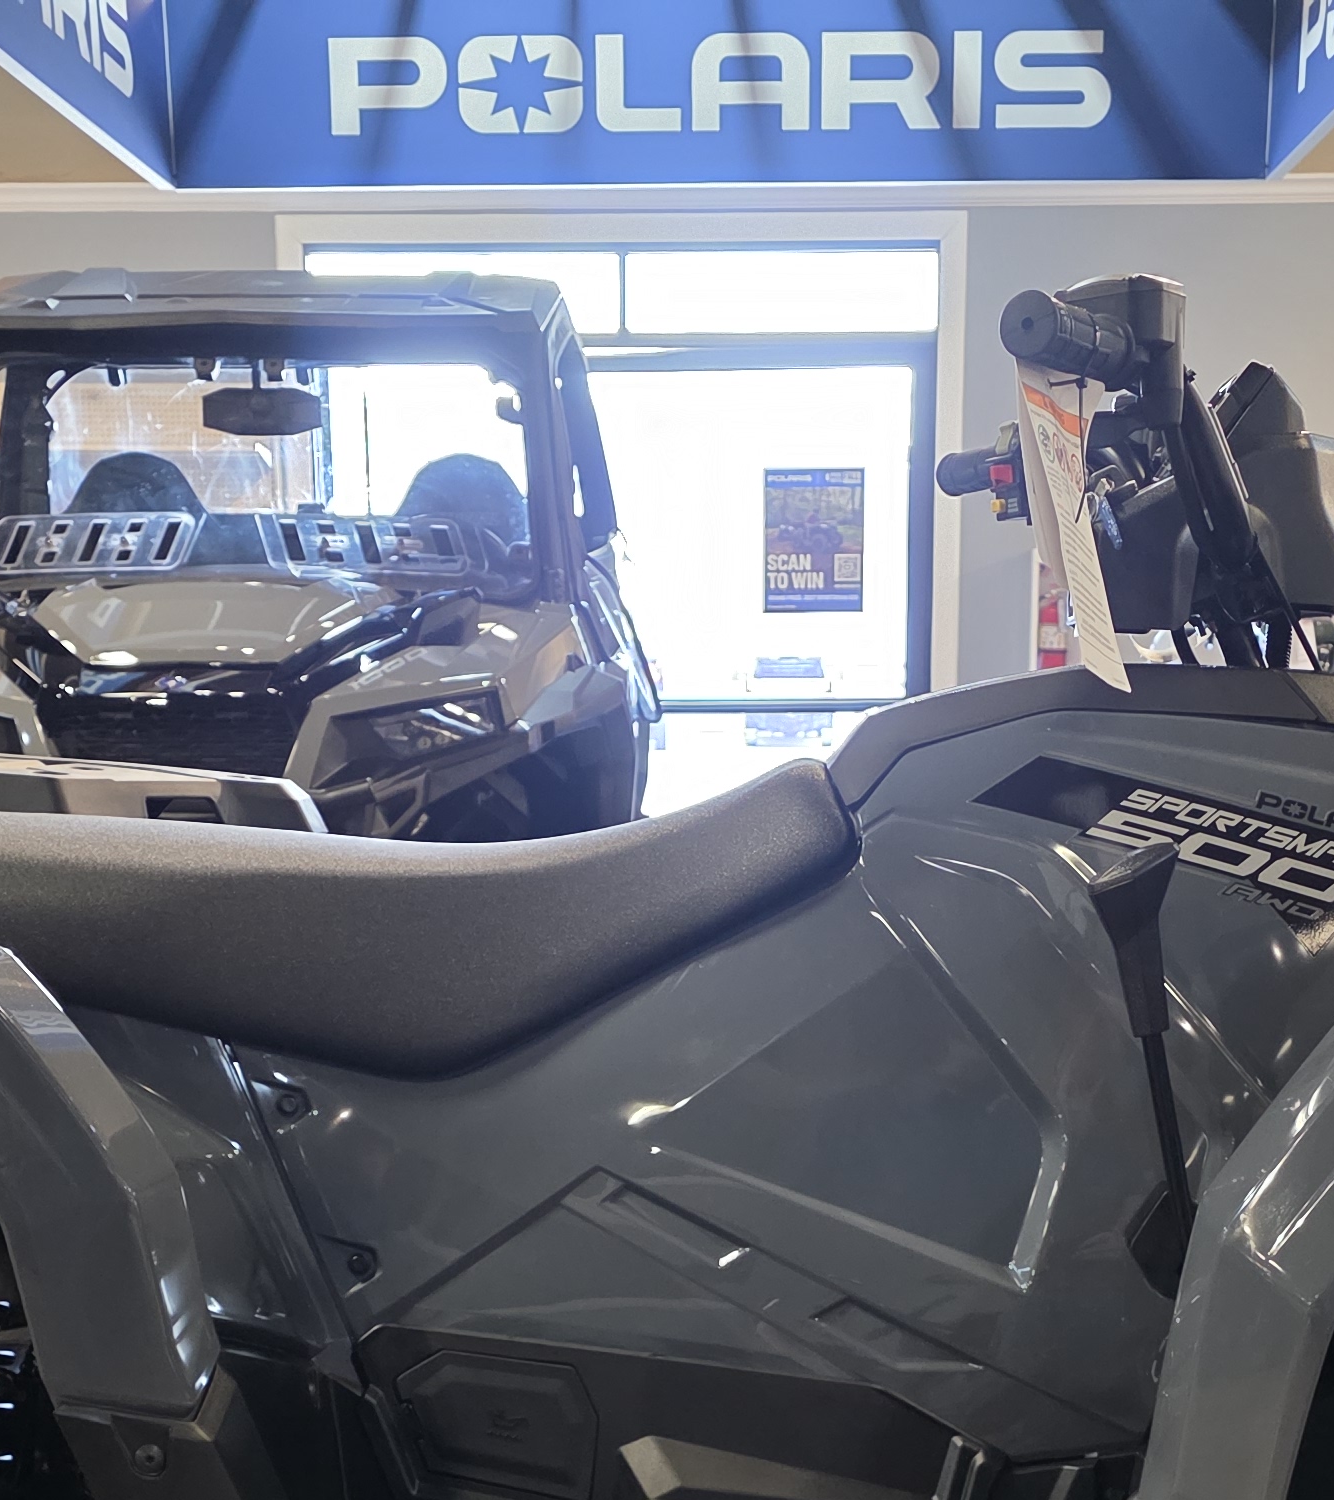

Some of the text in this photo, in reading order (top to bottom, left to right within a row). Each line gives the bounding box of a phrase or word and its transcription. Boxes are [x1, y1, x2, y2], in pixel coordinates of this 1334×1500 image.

[327, 29, 1112, 136] POLARIS
[767, 553, 812, 571] SCAN
[767, 571, 825, 590] TO WIN
[1221, 883, 1325, 921] AWD
